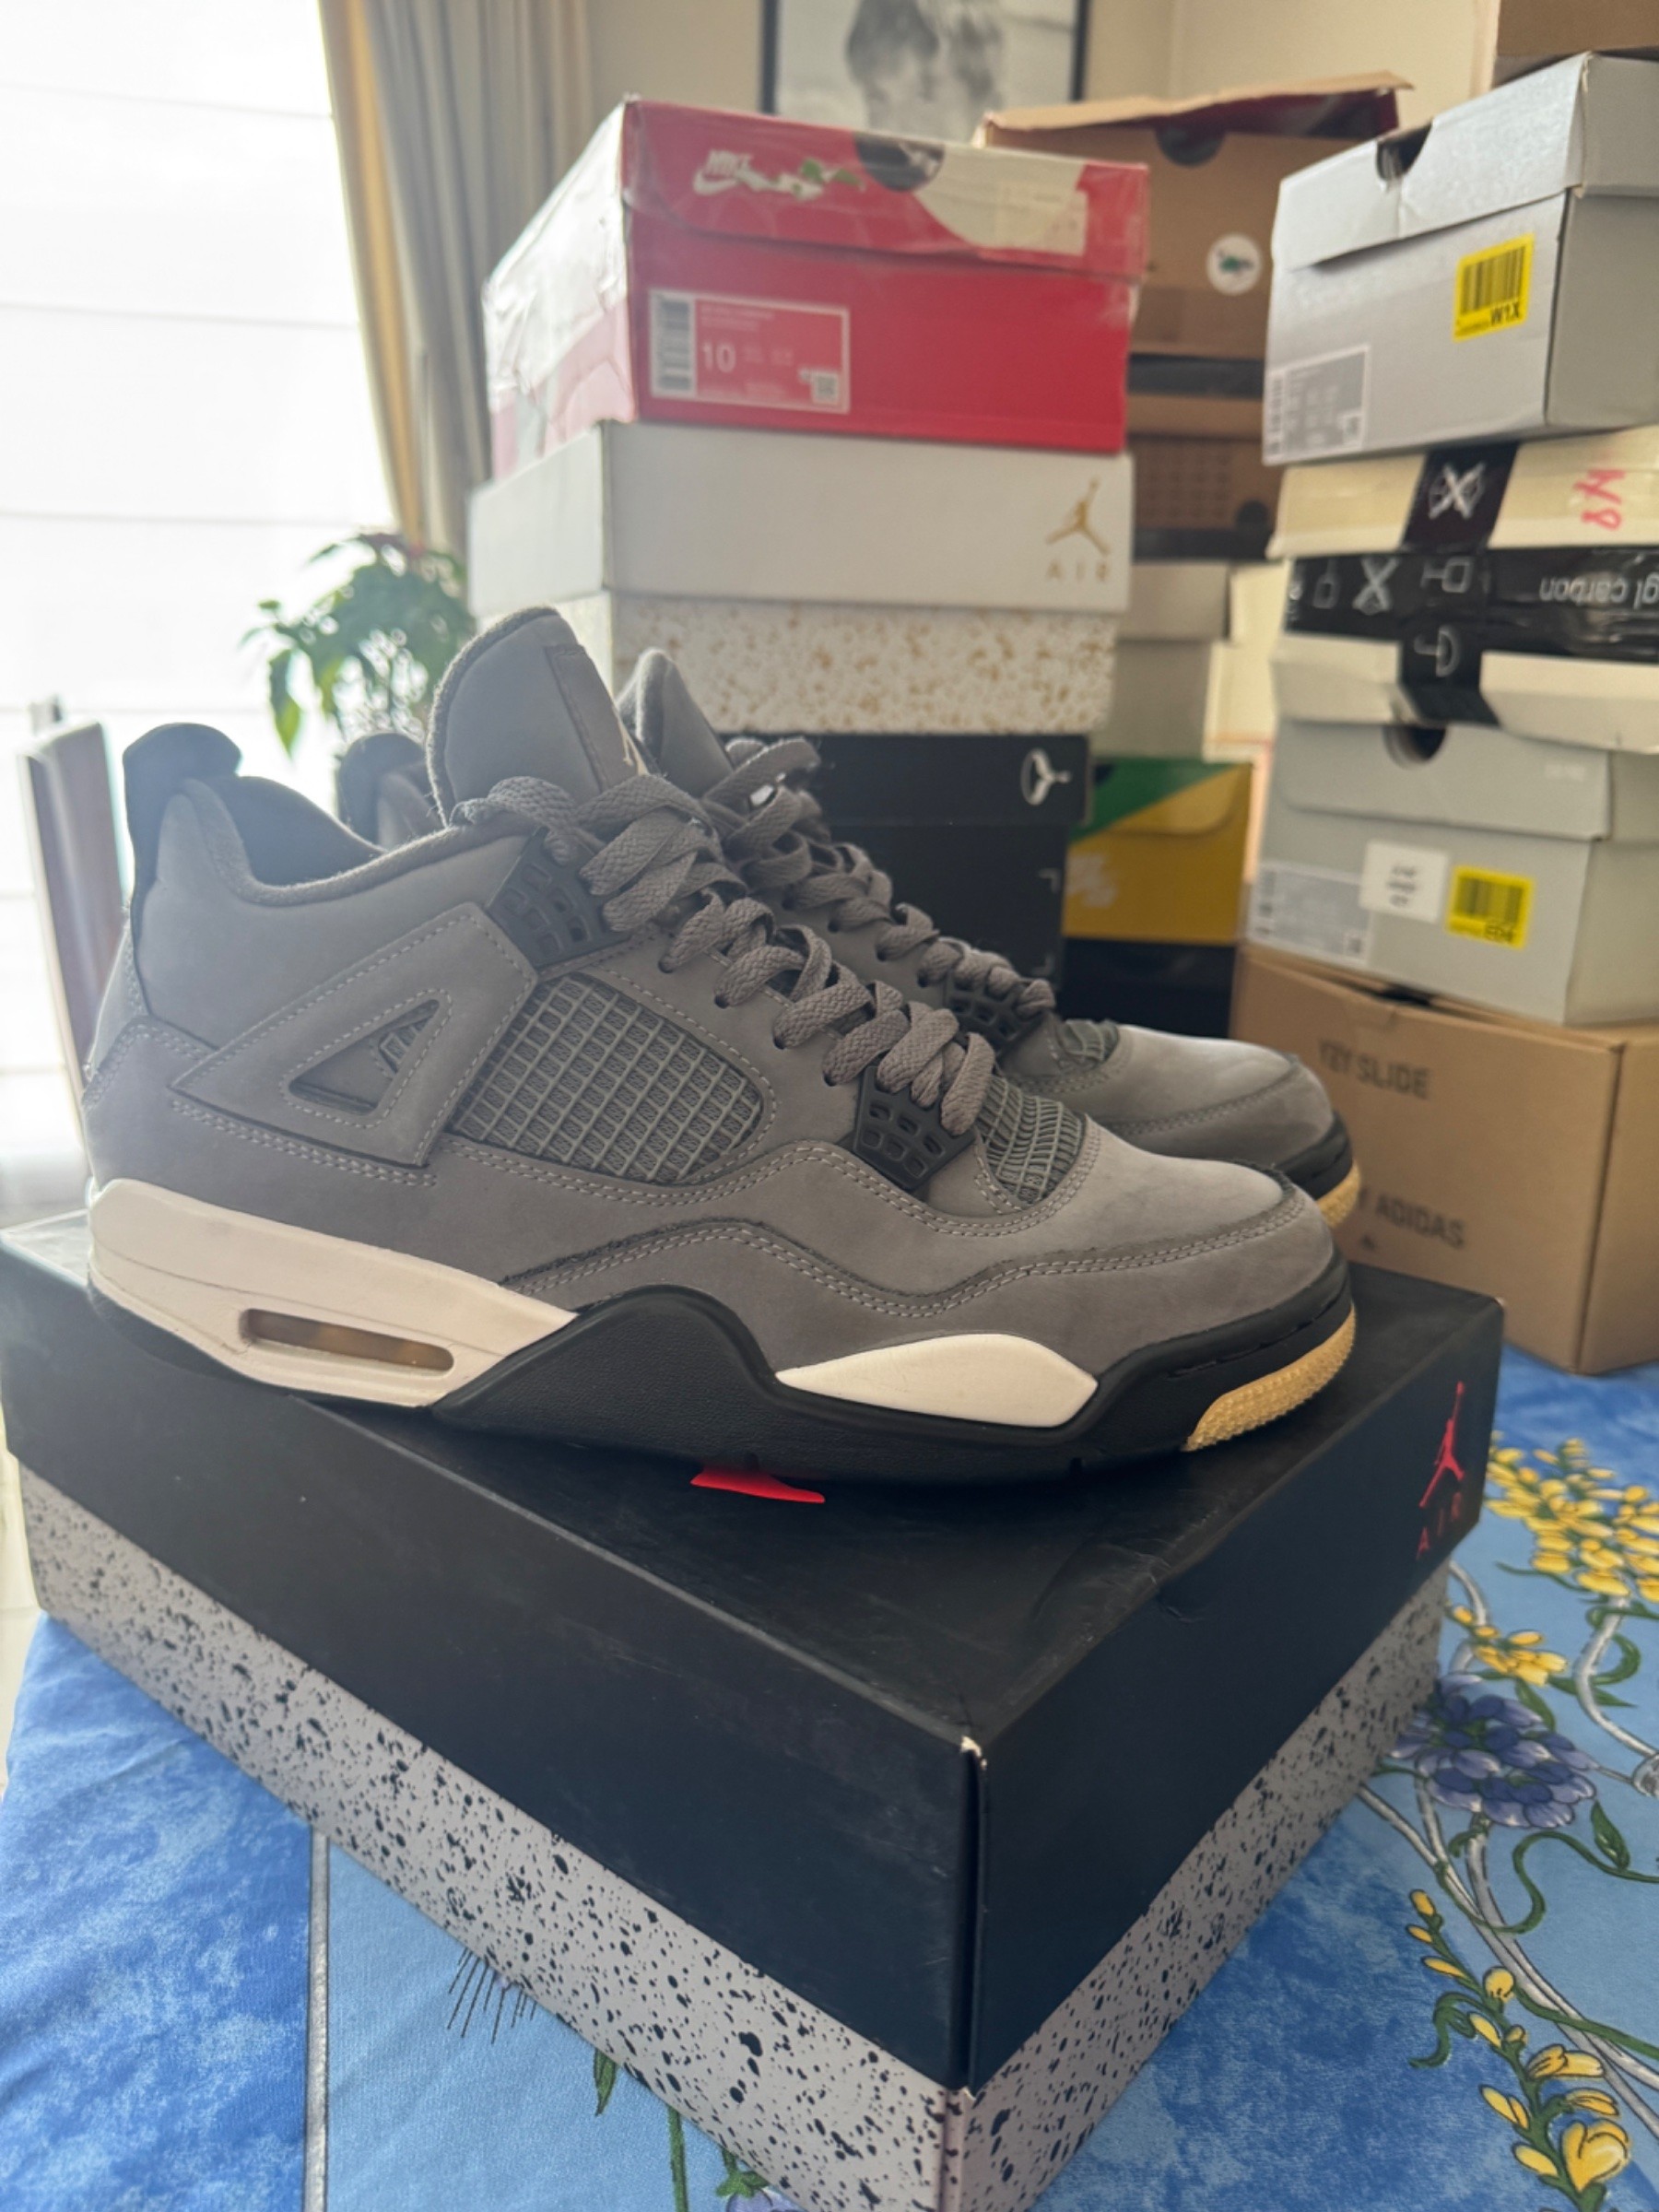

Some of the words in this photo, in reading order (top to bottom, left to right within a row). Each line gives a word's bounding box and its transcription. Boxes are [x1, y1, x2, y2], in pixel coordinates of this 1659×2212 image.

[700, 339, 736, 373] 10
[1044, 559, 1112, 584] AIR
[1538, 575, 1629, 606] carbon
[1356, 1054, 1430, 1100] SLIDE
[1375, 1194, 1466, 1250] ADIDAS
[1415, 1489, 1465, 1561] AIR
